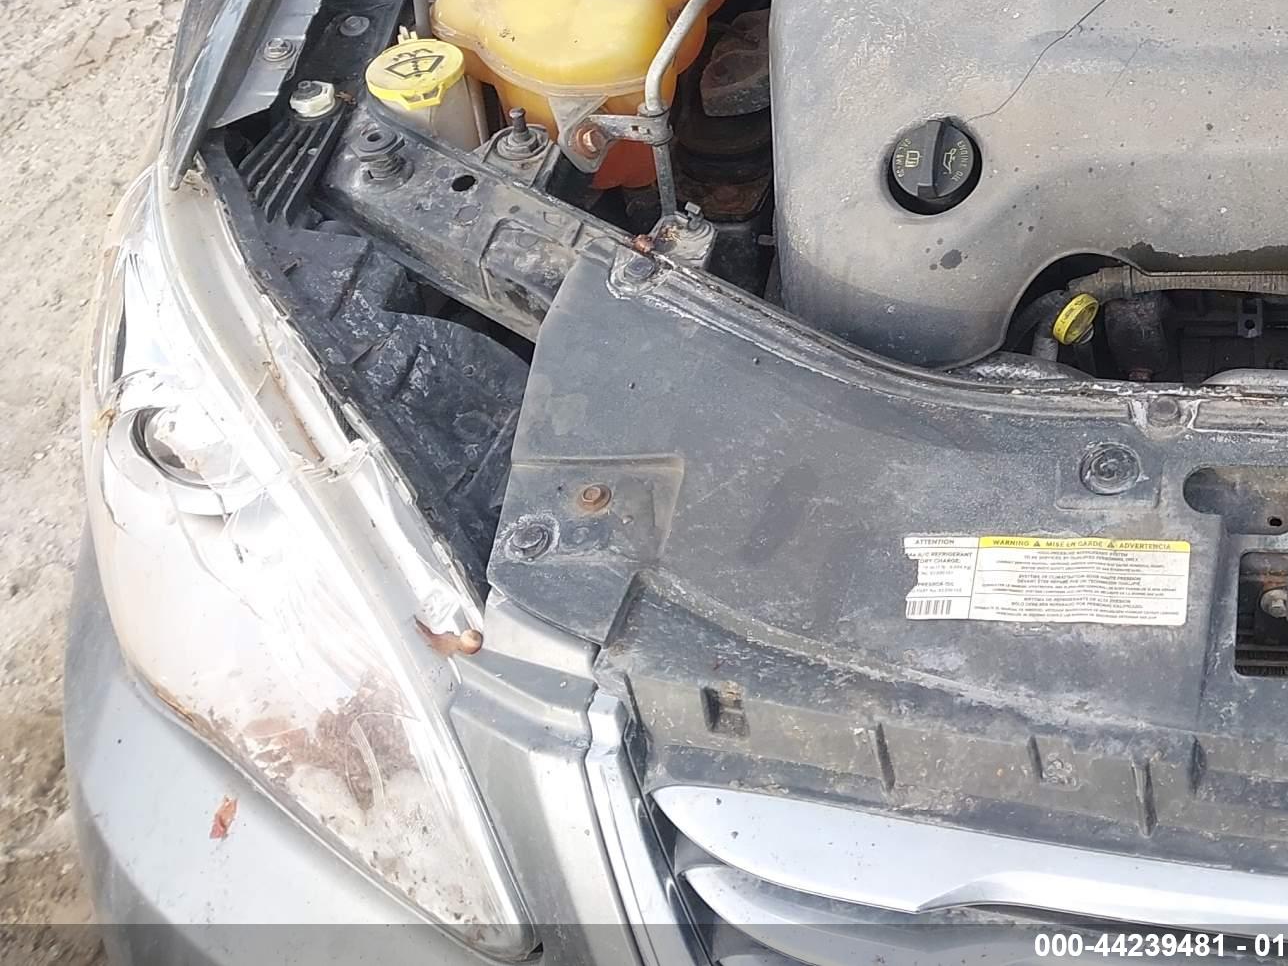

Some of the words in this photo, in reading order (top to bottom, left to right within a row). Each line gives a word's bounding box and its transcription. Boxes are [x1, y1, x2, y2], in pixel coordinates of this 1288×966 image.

[914, 538, 955, 546] ATTENTION
[992, 539, 1030, 547] WARNING
[1045, 540, 1064, 548] MISE
[1077, 540, 1103, 548] GARDE
[1118, 541, 1172, 550] ADVERTENCIA
